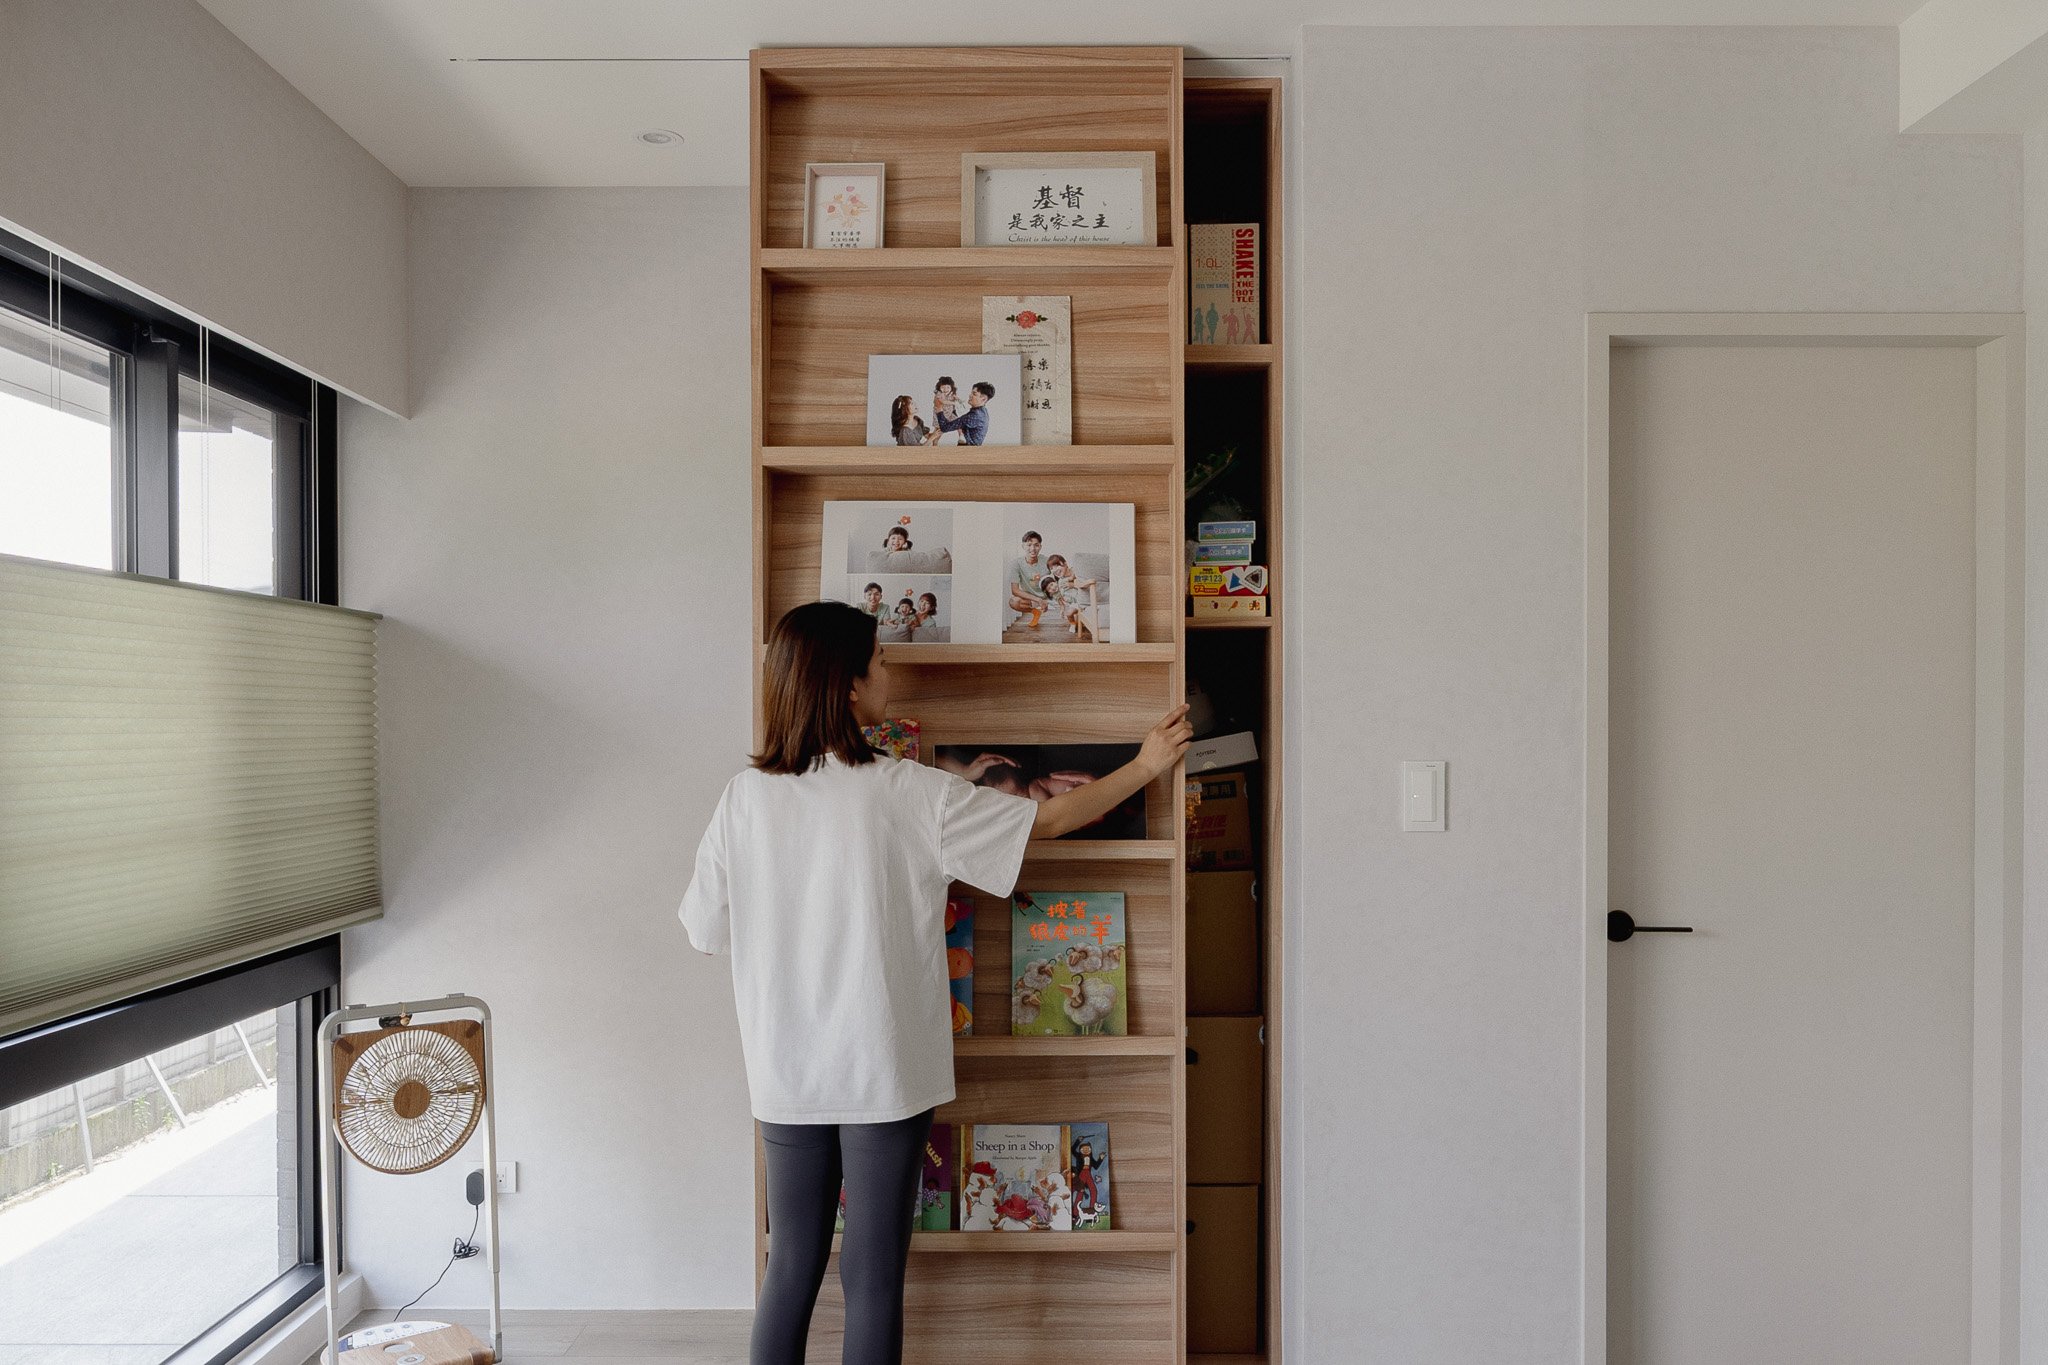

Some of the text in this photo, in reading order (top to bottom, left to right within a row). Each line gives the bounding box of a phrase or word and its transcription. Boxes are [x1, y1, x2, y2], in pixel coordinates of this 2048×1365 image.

[1032, 184, 1084, 209] 基督
[1008, 213, 1110, 231] 是我家之主
[1008, 233, 1032, 242] Christ
[1069, 235, 1077, 243] of
[1235, 228, 1254, 278] SHAKE
[1046, 899, 1088, 919] 披著
[975, 1141, 1005, 1154] Sheep
[1008, 1141, 1018, 1151] in
[1028, 1141, 1055, 1154] Shop
